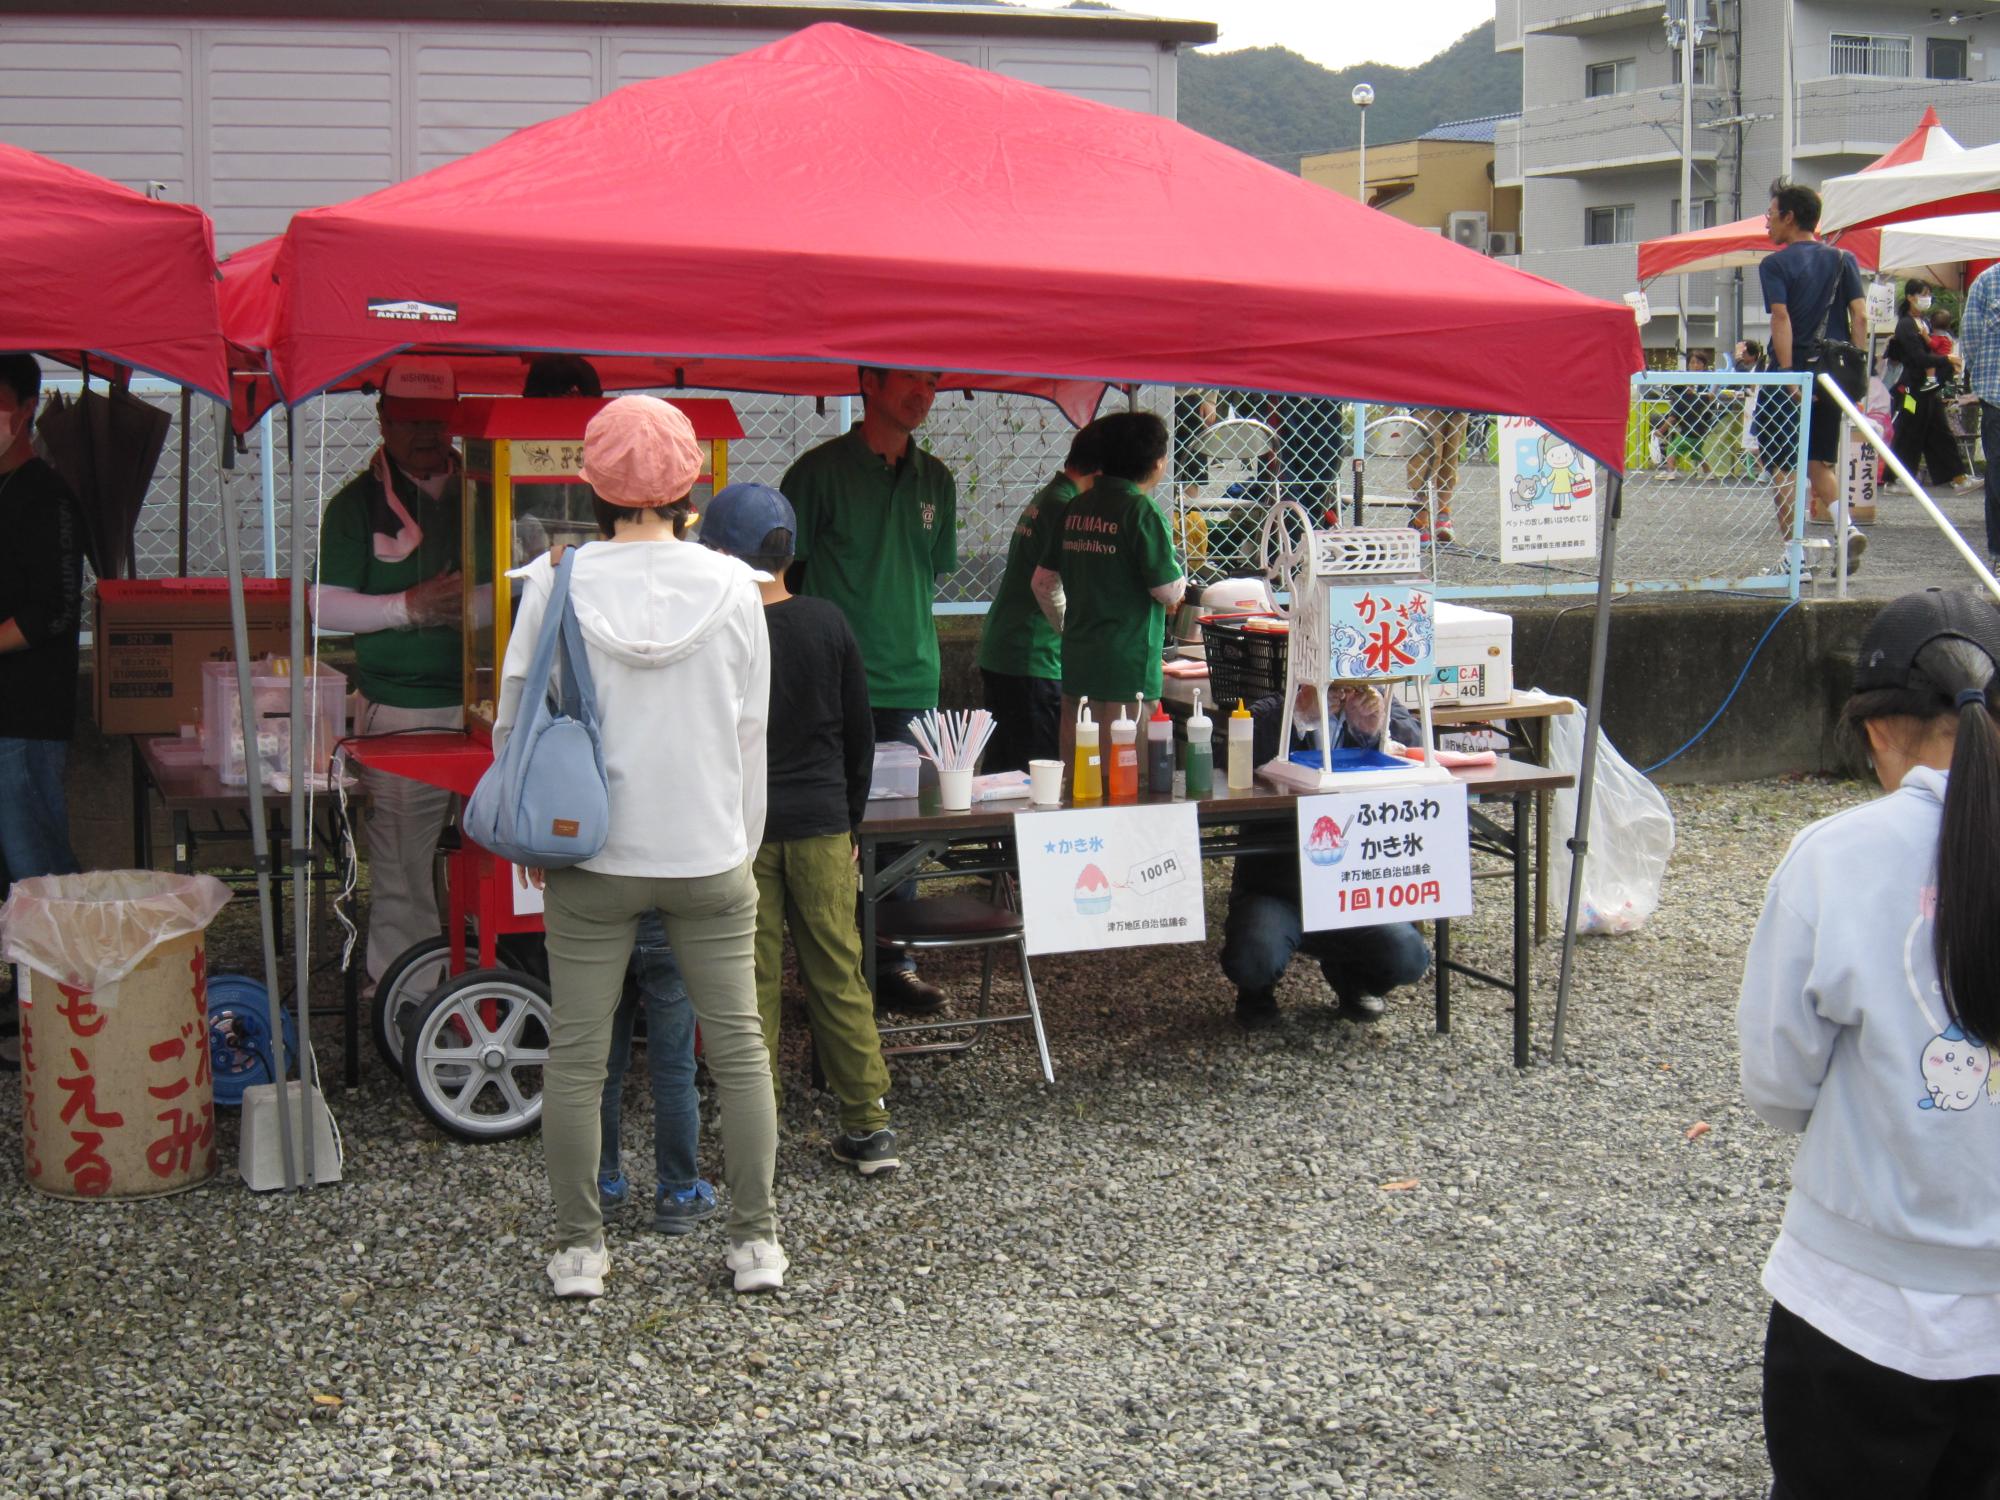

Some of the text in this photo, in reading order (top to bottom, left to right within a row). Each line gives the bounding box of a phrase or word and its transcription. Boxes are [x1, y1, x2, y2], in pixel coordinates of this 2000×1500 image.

[1362, 621, 1417, 674] 氷
[1461, 685, 1478, 697] 40
[1357, 798, 1441, 827] ふわふわ
[1361, 832, 1424, 861] かき氷
[1140, 858, 1177, 883] 100円
[1340, 863, 1432, 884] 津万地区自治協議会
[1338, 880, 1441, 913] 1回100円
[1107, 916, 1188, 932] 津万地区自治協議会
[56, 971, 124, 1196] もえる
[146, 1022, 203, 1178] ごみ
